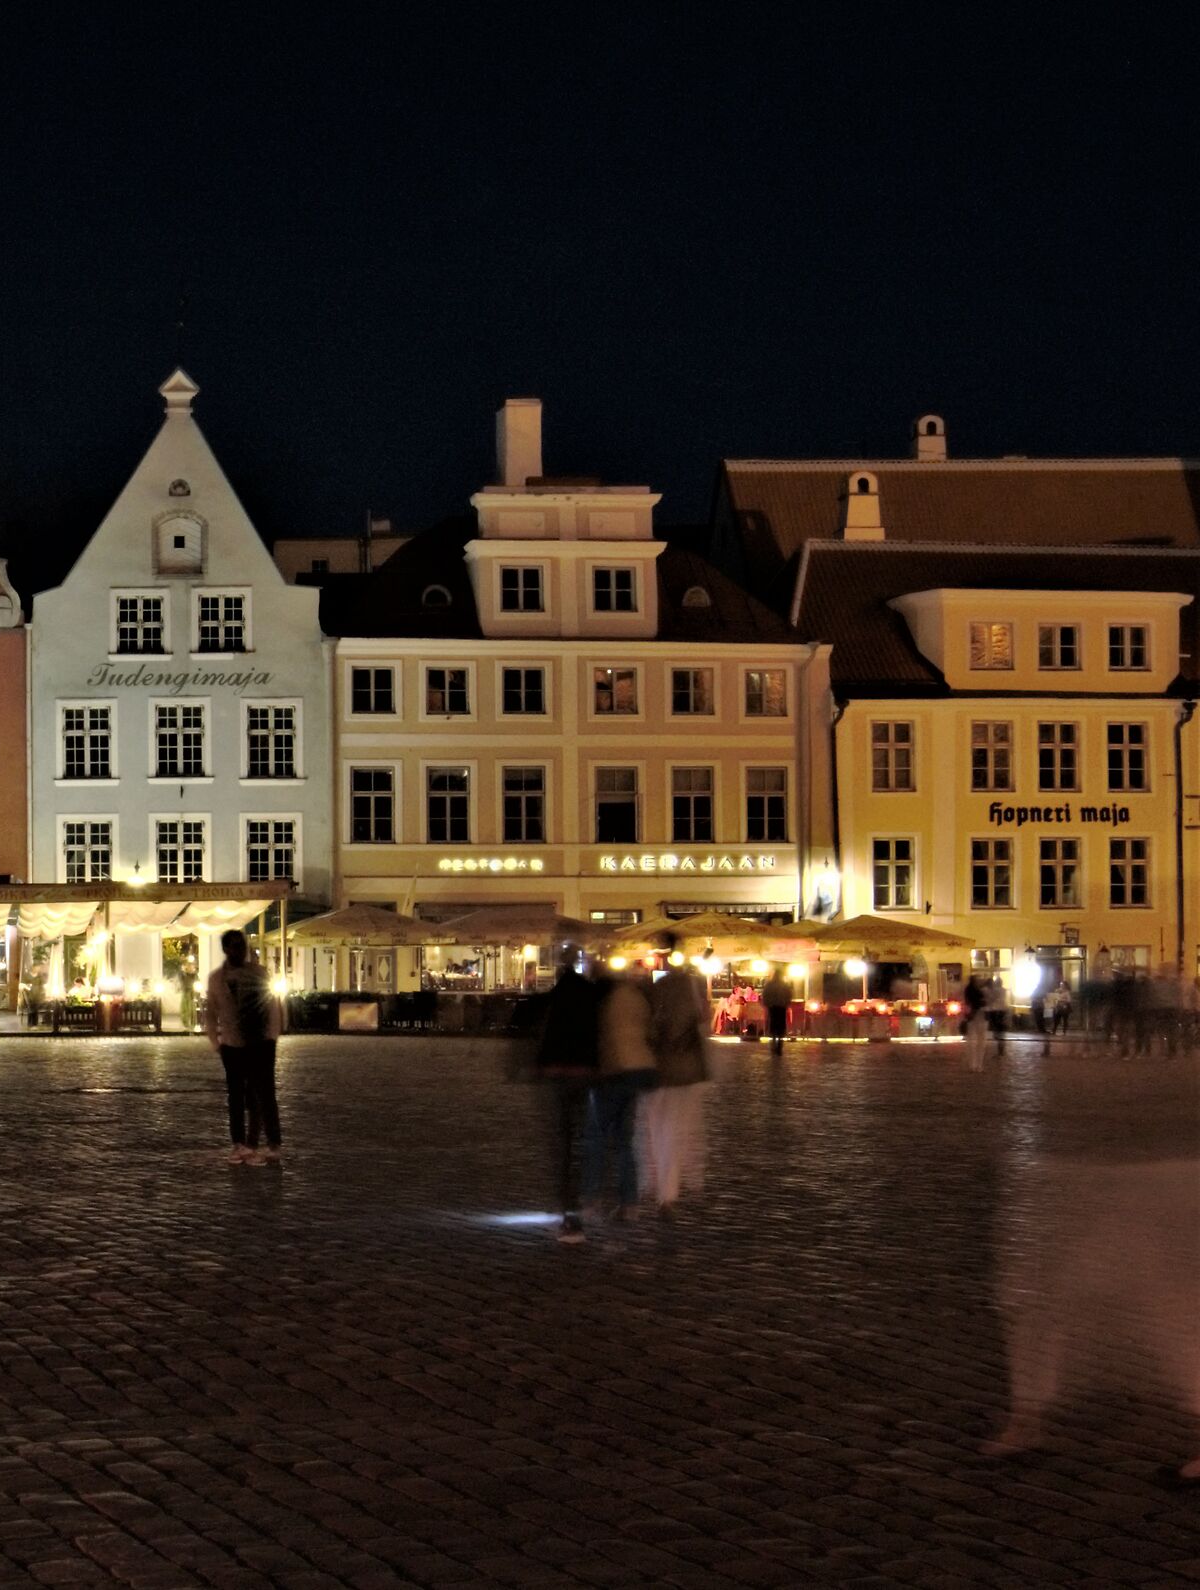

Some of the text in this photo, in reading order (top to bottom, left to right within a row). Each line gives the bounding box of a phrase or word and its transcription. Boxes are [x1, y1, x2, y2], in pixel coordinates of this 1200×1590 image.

[87, 663, 275, 696] Tudengimaja
[1080, 803, 1130, 827] maja
[600, 855, 776, 871] KAERAJAAN
